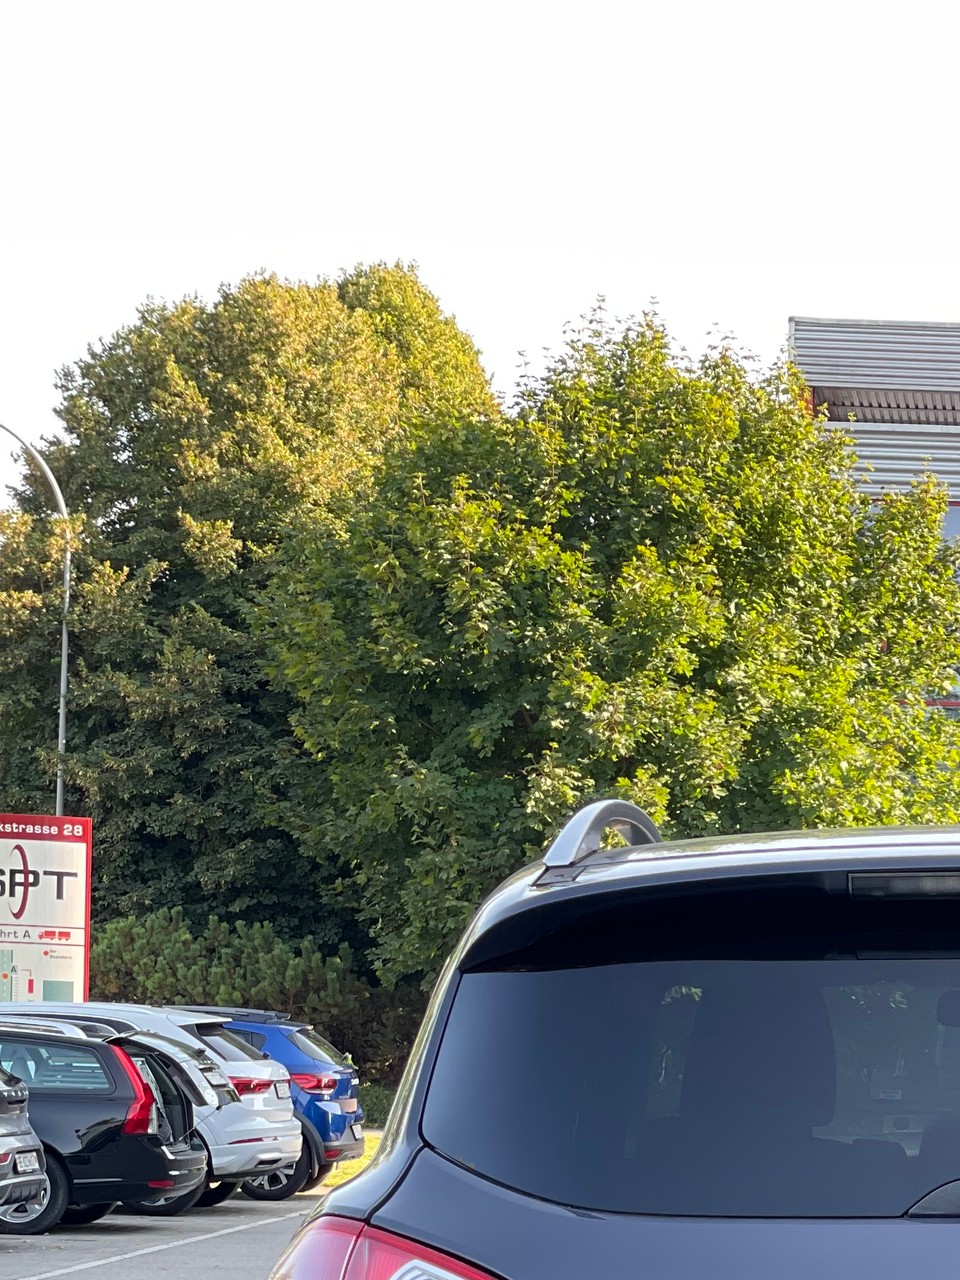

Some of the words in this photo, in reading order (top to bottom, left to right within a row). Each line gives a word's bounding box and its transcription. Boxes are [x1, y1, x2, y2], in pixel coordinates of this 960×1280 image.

[63, 824, 83, 836] 28
[0, 868, 78, 899] PT
[23, 930, 31, 939] A
